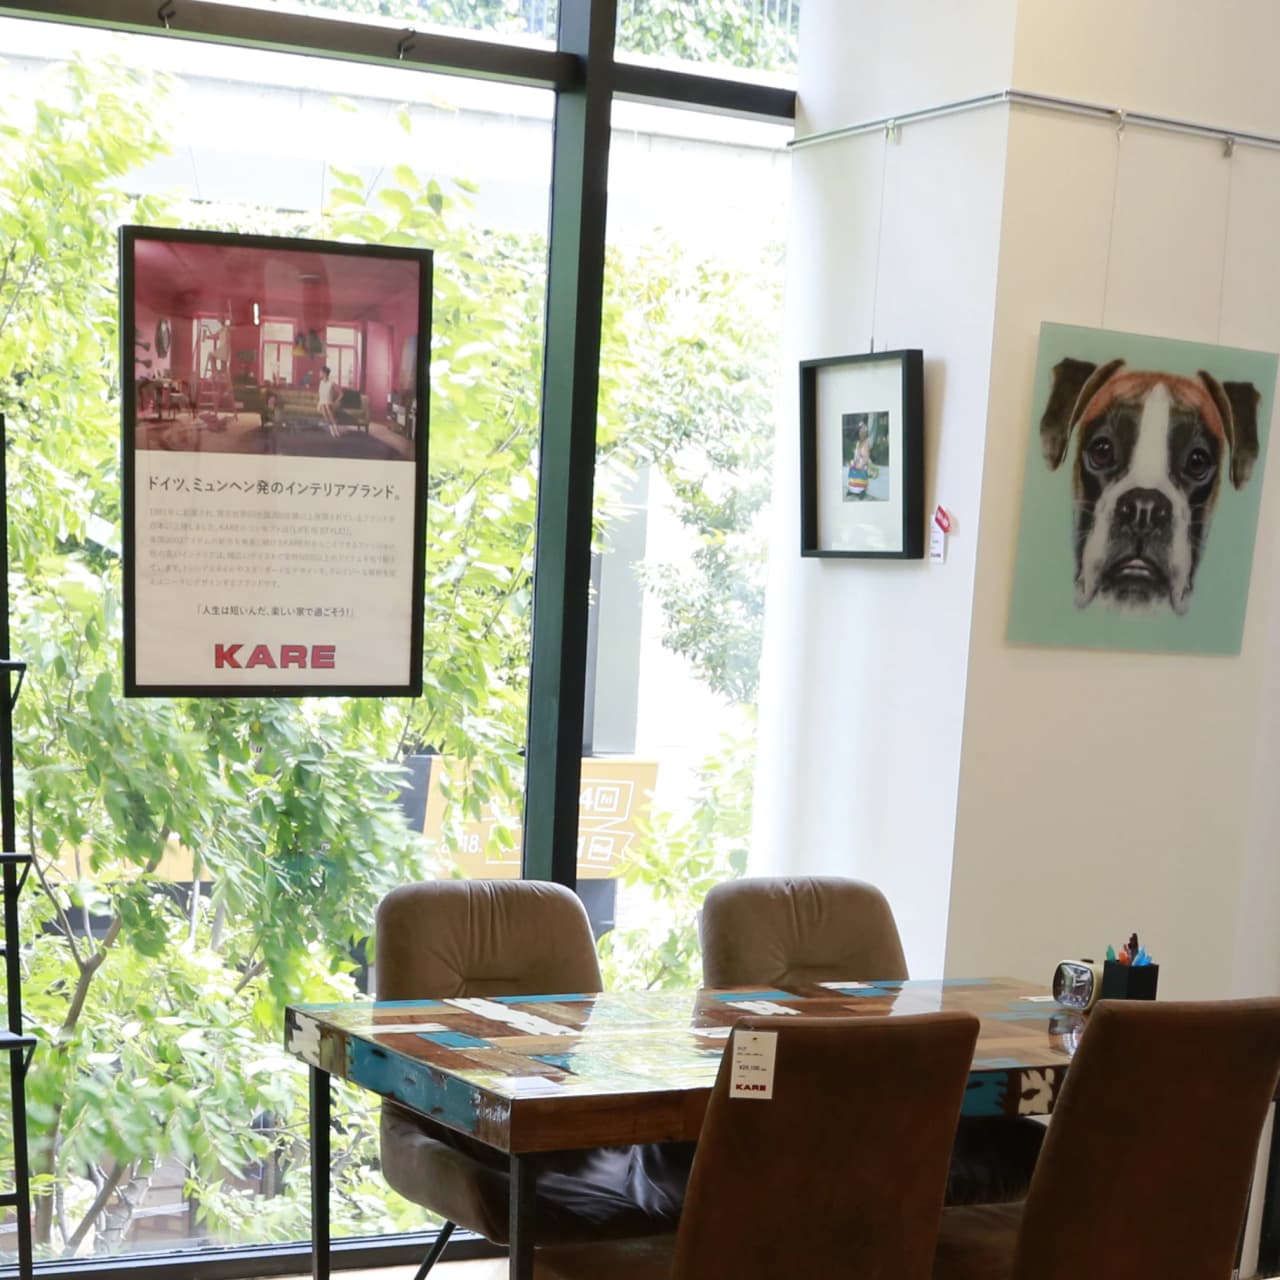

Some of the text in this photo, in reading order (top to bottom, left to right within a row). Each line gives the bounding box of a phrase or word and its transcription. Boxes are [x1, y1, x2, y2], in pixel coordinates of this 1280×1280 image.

[148, 475, 400, 501] ドイツ、ミュンヘン発のインテリアブランド。
[214, 643, 336, 669] KARE
[735, 1084, 767, 1092] KARE
